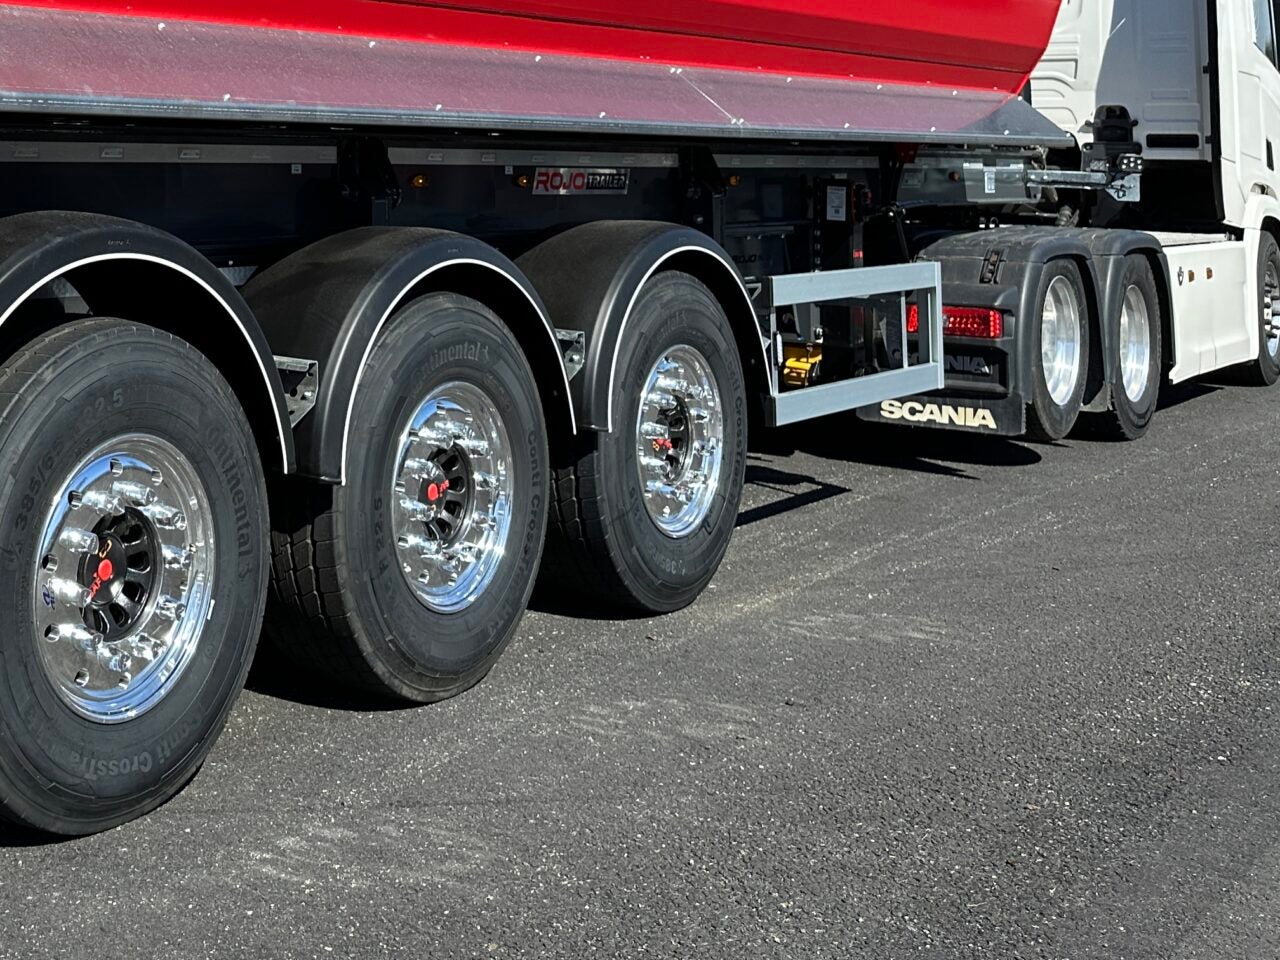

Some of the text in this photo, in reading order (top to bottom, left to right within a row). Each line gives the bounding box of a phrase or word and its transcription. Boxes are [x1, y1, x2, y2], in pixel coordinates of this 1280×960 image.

[535, 172, 625, 191] ROJO TRAILER
[880, 400, 998, 429] SCANIA
[527, 429, 542, 488] Conti
